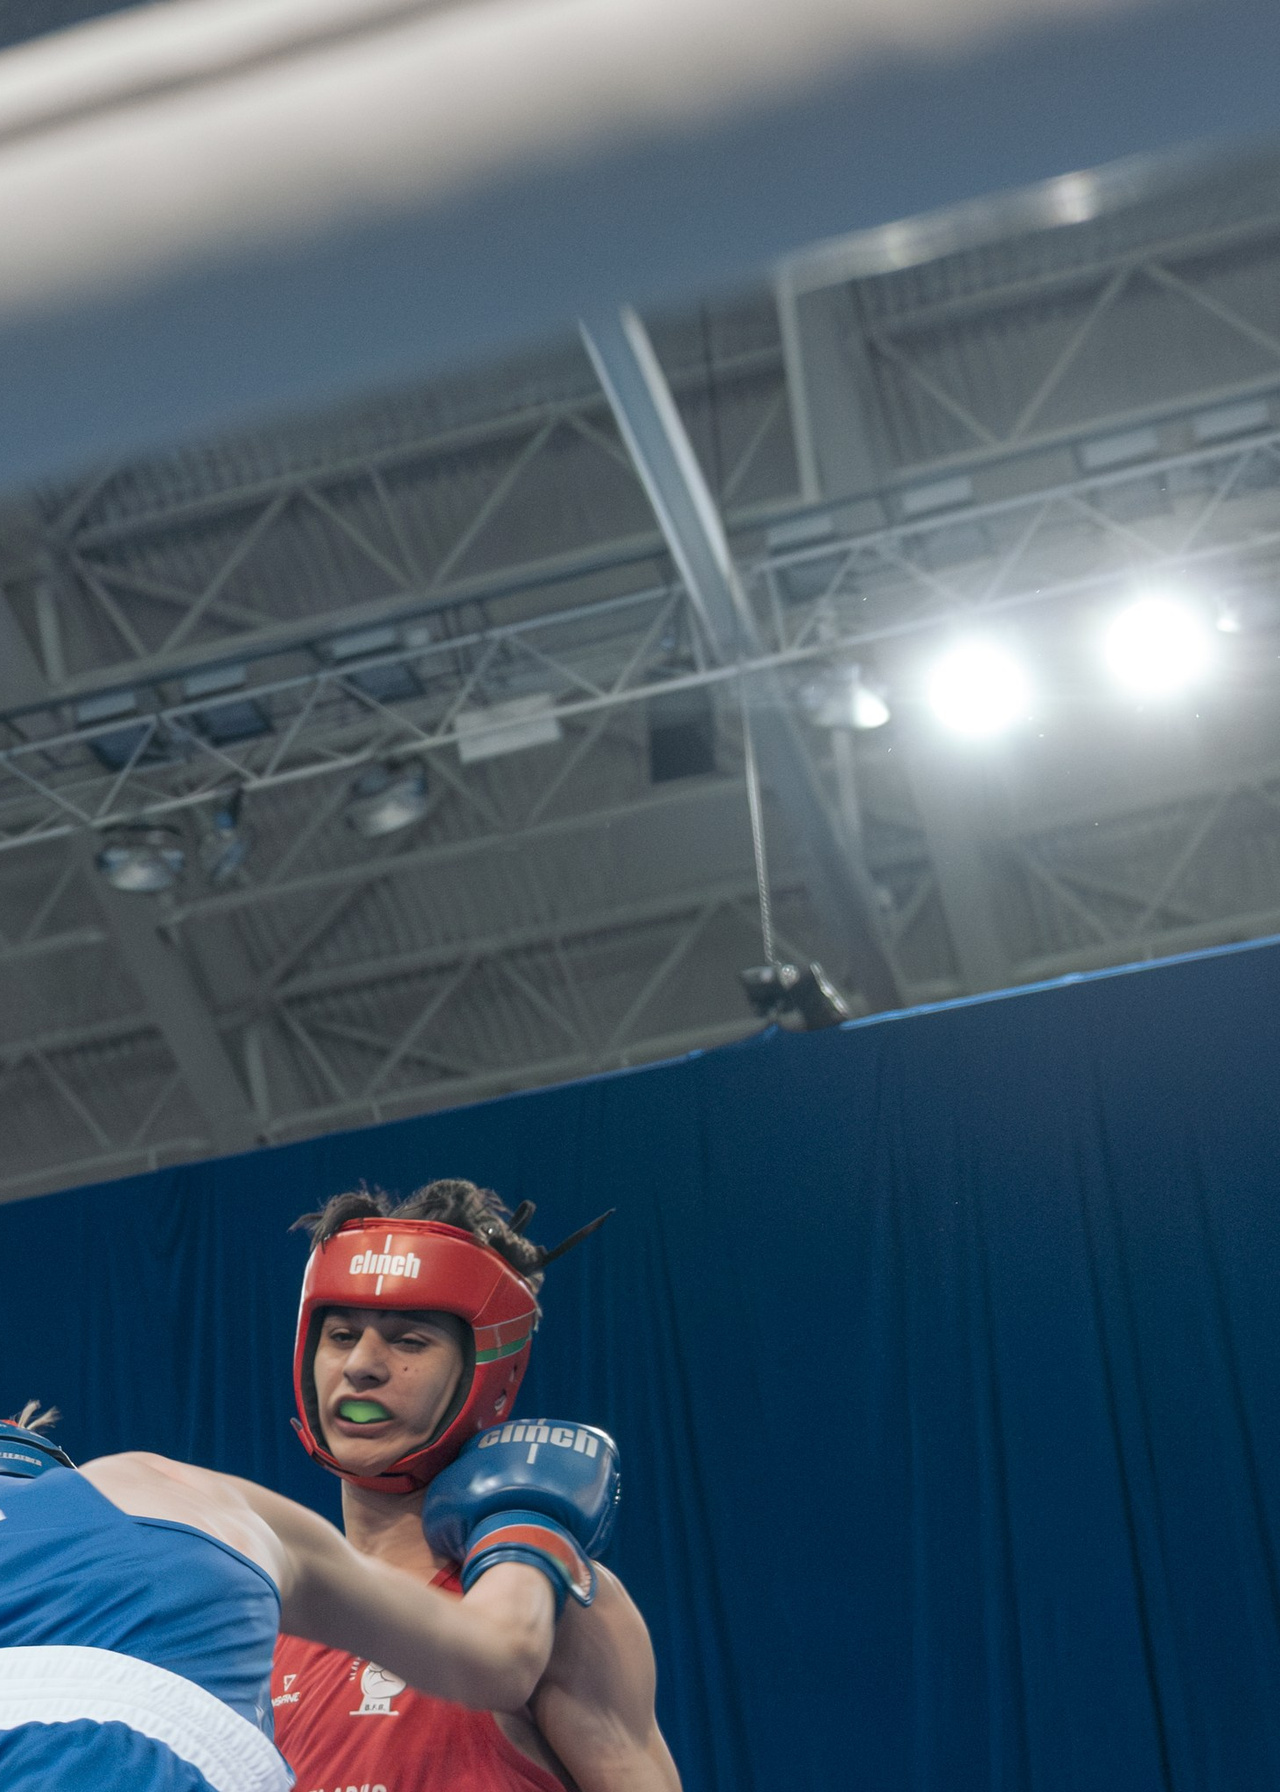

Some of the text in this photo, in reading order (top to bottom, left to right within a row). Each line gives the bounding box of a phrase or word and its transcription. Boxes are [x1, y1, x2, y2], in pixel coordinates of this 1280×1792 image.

[349, 1249, 421, 1279] clinch
[478, 1424, 599, 1459] clinch
[271, 1691, 300, 1707] NSANE
